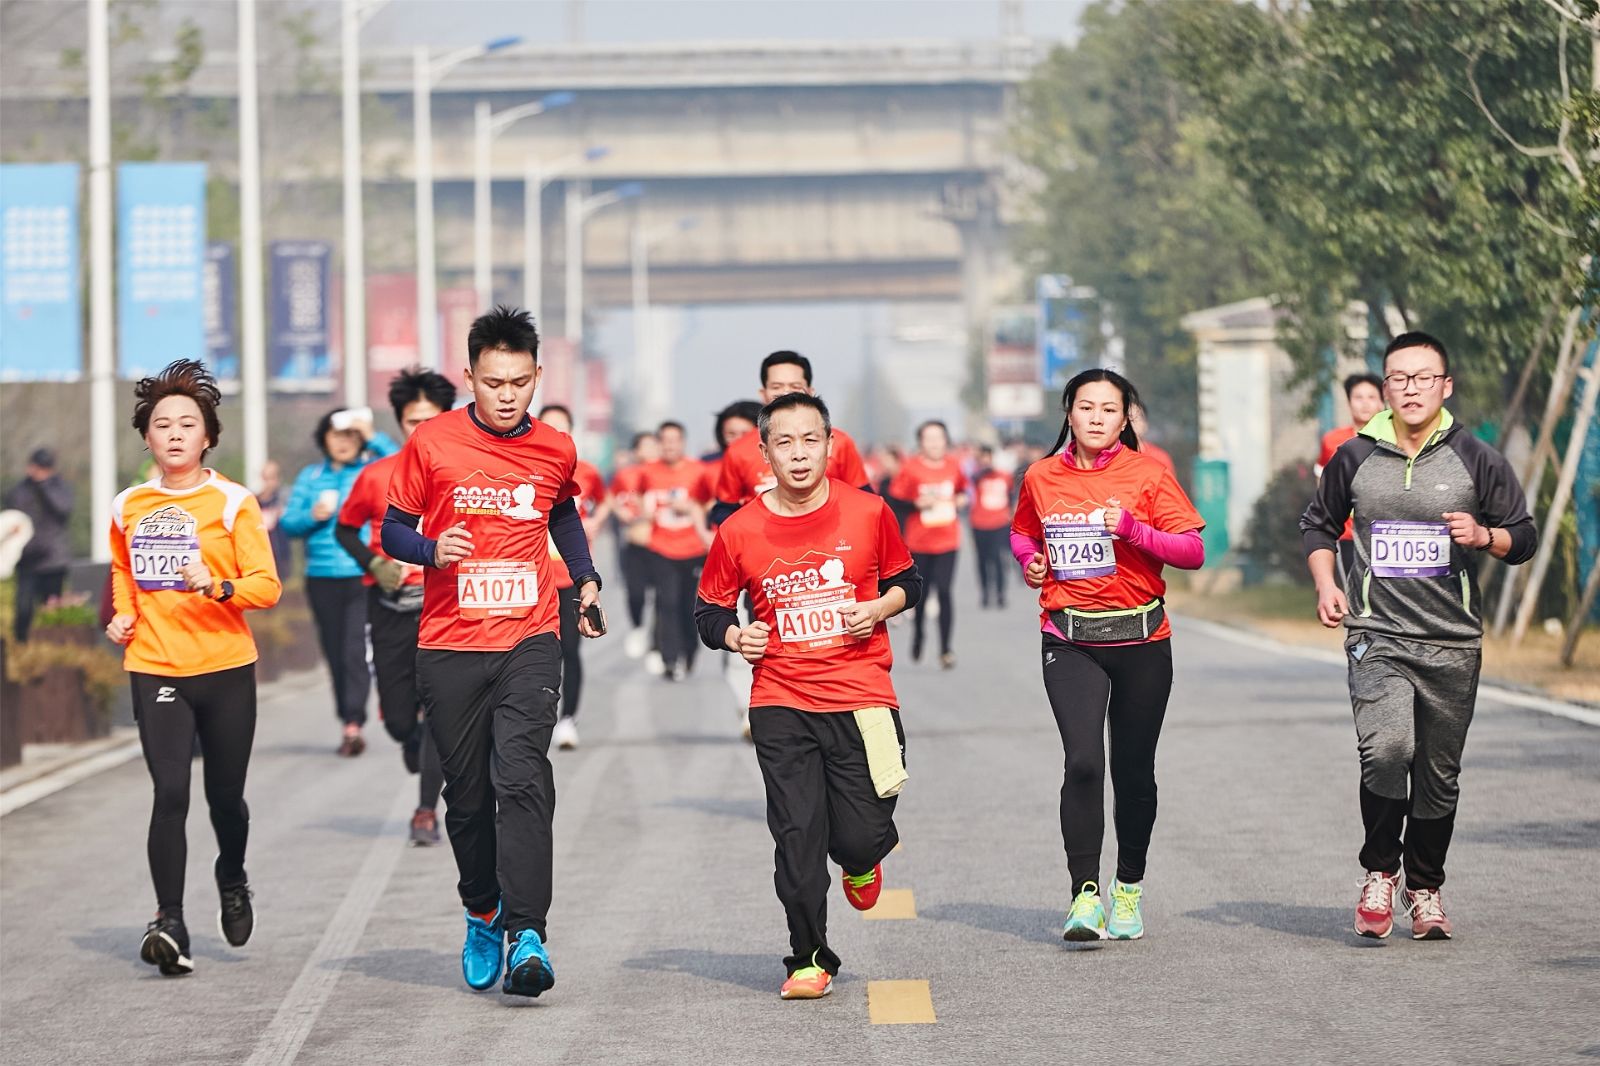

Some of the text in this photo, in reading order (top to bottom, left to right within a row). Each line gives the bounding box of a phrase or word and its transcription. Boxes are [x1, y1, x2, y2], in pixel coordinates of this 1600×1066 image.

[453, 486, 511, 510] 2020
[1048, 543, 1104, 564] D1249
[1375, 540, 1439, 561] D1059
[461, 578, 526, 602] A1071
[761, 568, 820, 599] 2020
